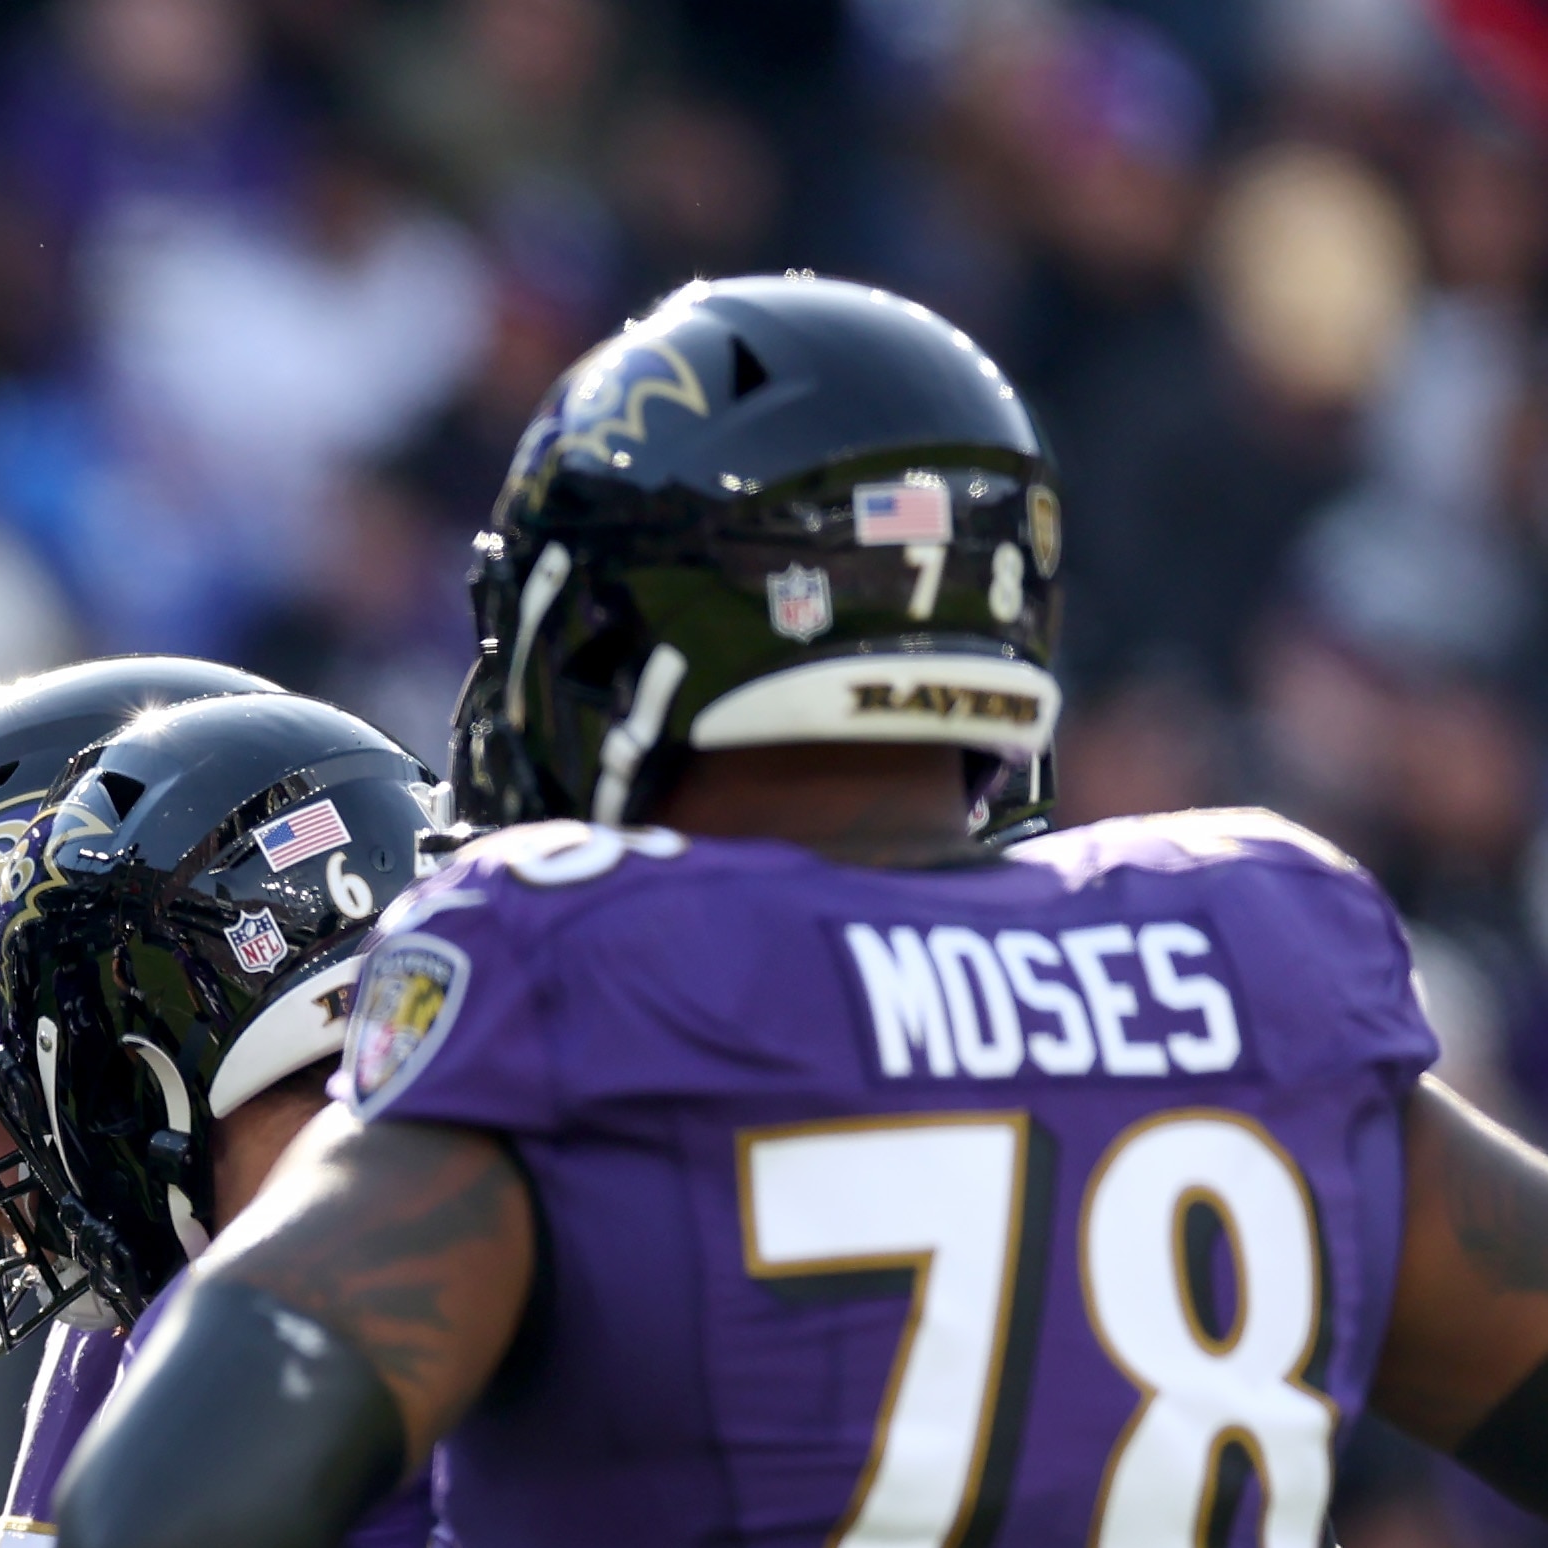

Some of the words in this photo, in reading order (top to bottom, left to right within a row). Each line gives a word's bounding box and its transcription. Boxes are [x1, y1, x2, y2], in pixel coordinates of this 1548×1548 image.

[848, 683, 1041, 722] RAVENS
[241, 933, 280, 966] NFL
[845, 921, 1243, 1079] MOSES
